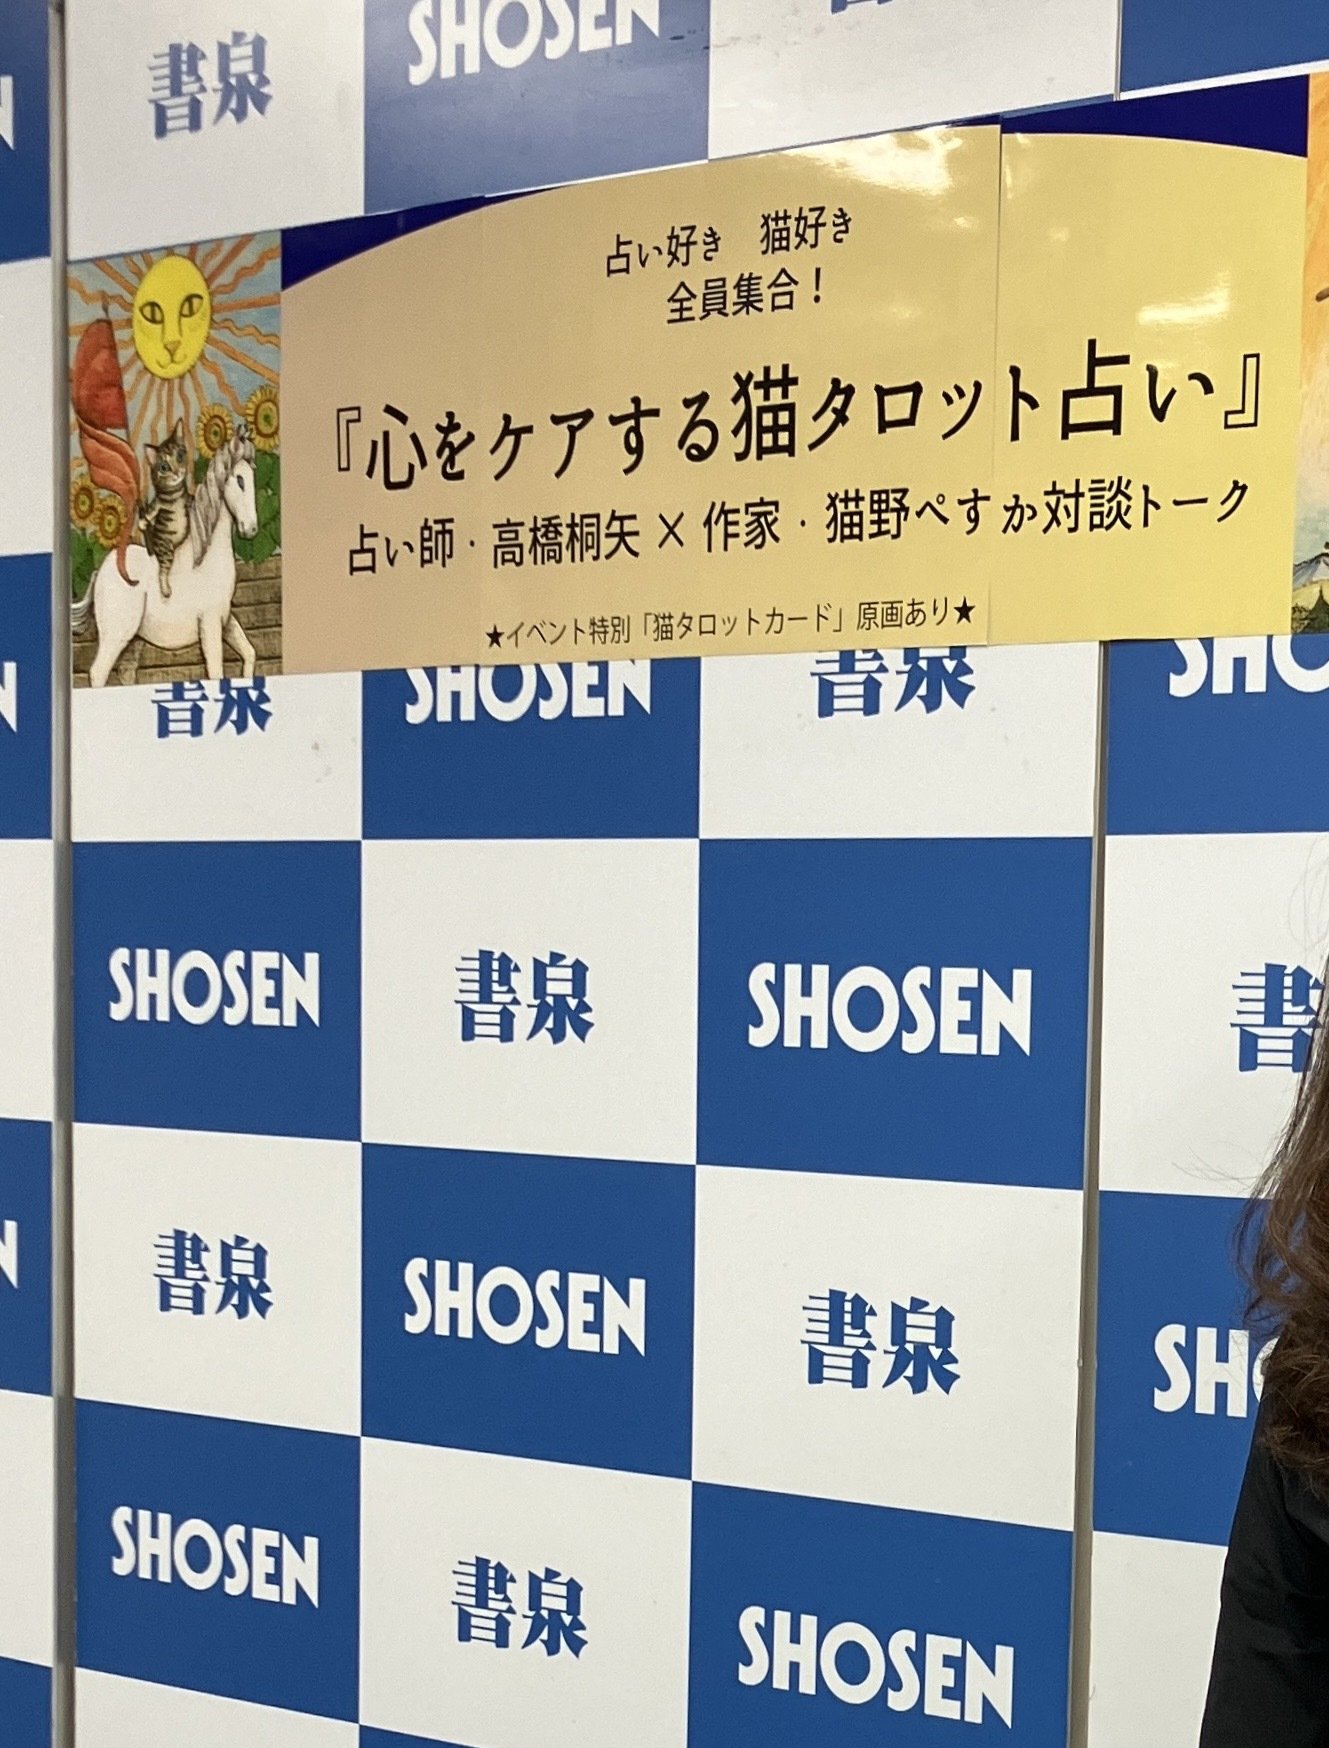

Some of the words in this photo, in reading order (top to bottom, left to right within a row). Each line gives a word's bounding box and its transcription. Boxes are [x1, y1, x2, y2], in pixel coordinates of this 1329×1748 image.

[147, 29, 274, 140] 書泉
[409, 0, 659, 85] SHOSEN
[605, 223, 726, 279] 占い好き
[760, 206, 851, 255] 猫好き
[665, 266, 826, 327] 全員集合！
[334, 338, 1262, 492] 『心をケアする猫タロット占い』
[404, 656, 651, 725] SHOSEN
[110, 948, 319, 1026] SHOSEN
[455, 949, 594, 1045] 書泉
[749, 963, 1031, 1056] SHOSEN
[1231, 963, 1325, 1072] 書
[153, 1230, 274, 1319] 書泉
[405, 1258, 645, 1356] SHOSEN
[799, 1288, 961, 1396] 書泉
[112, 1506, 318, 1608] SHOSEN
[451, 1557, 588, 1657] 書泉
[739, 1606, 1013, 1728] SHOSEN
